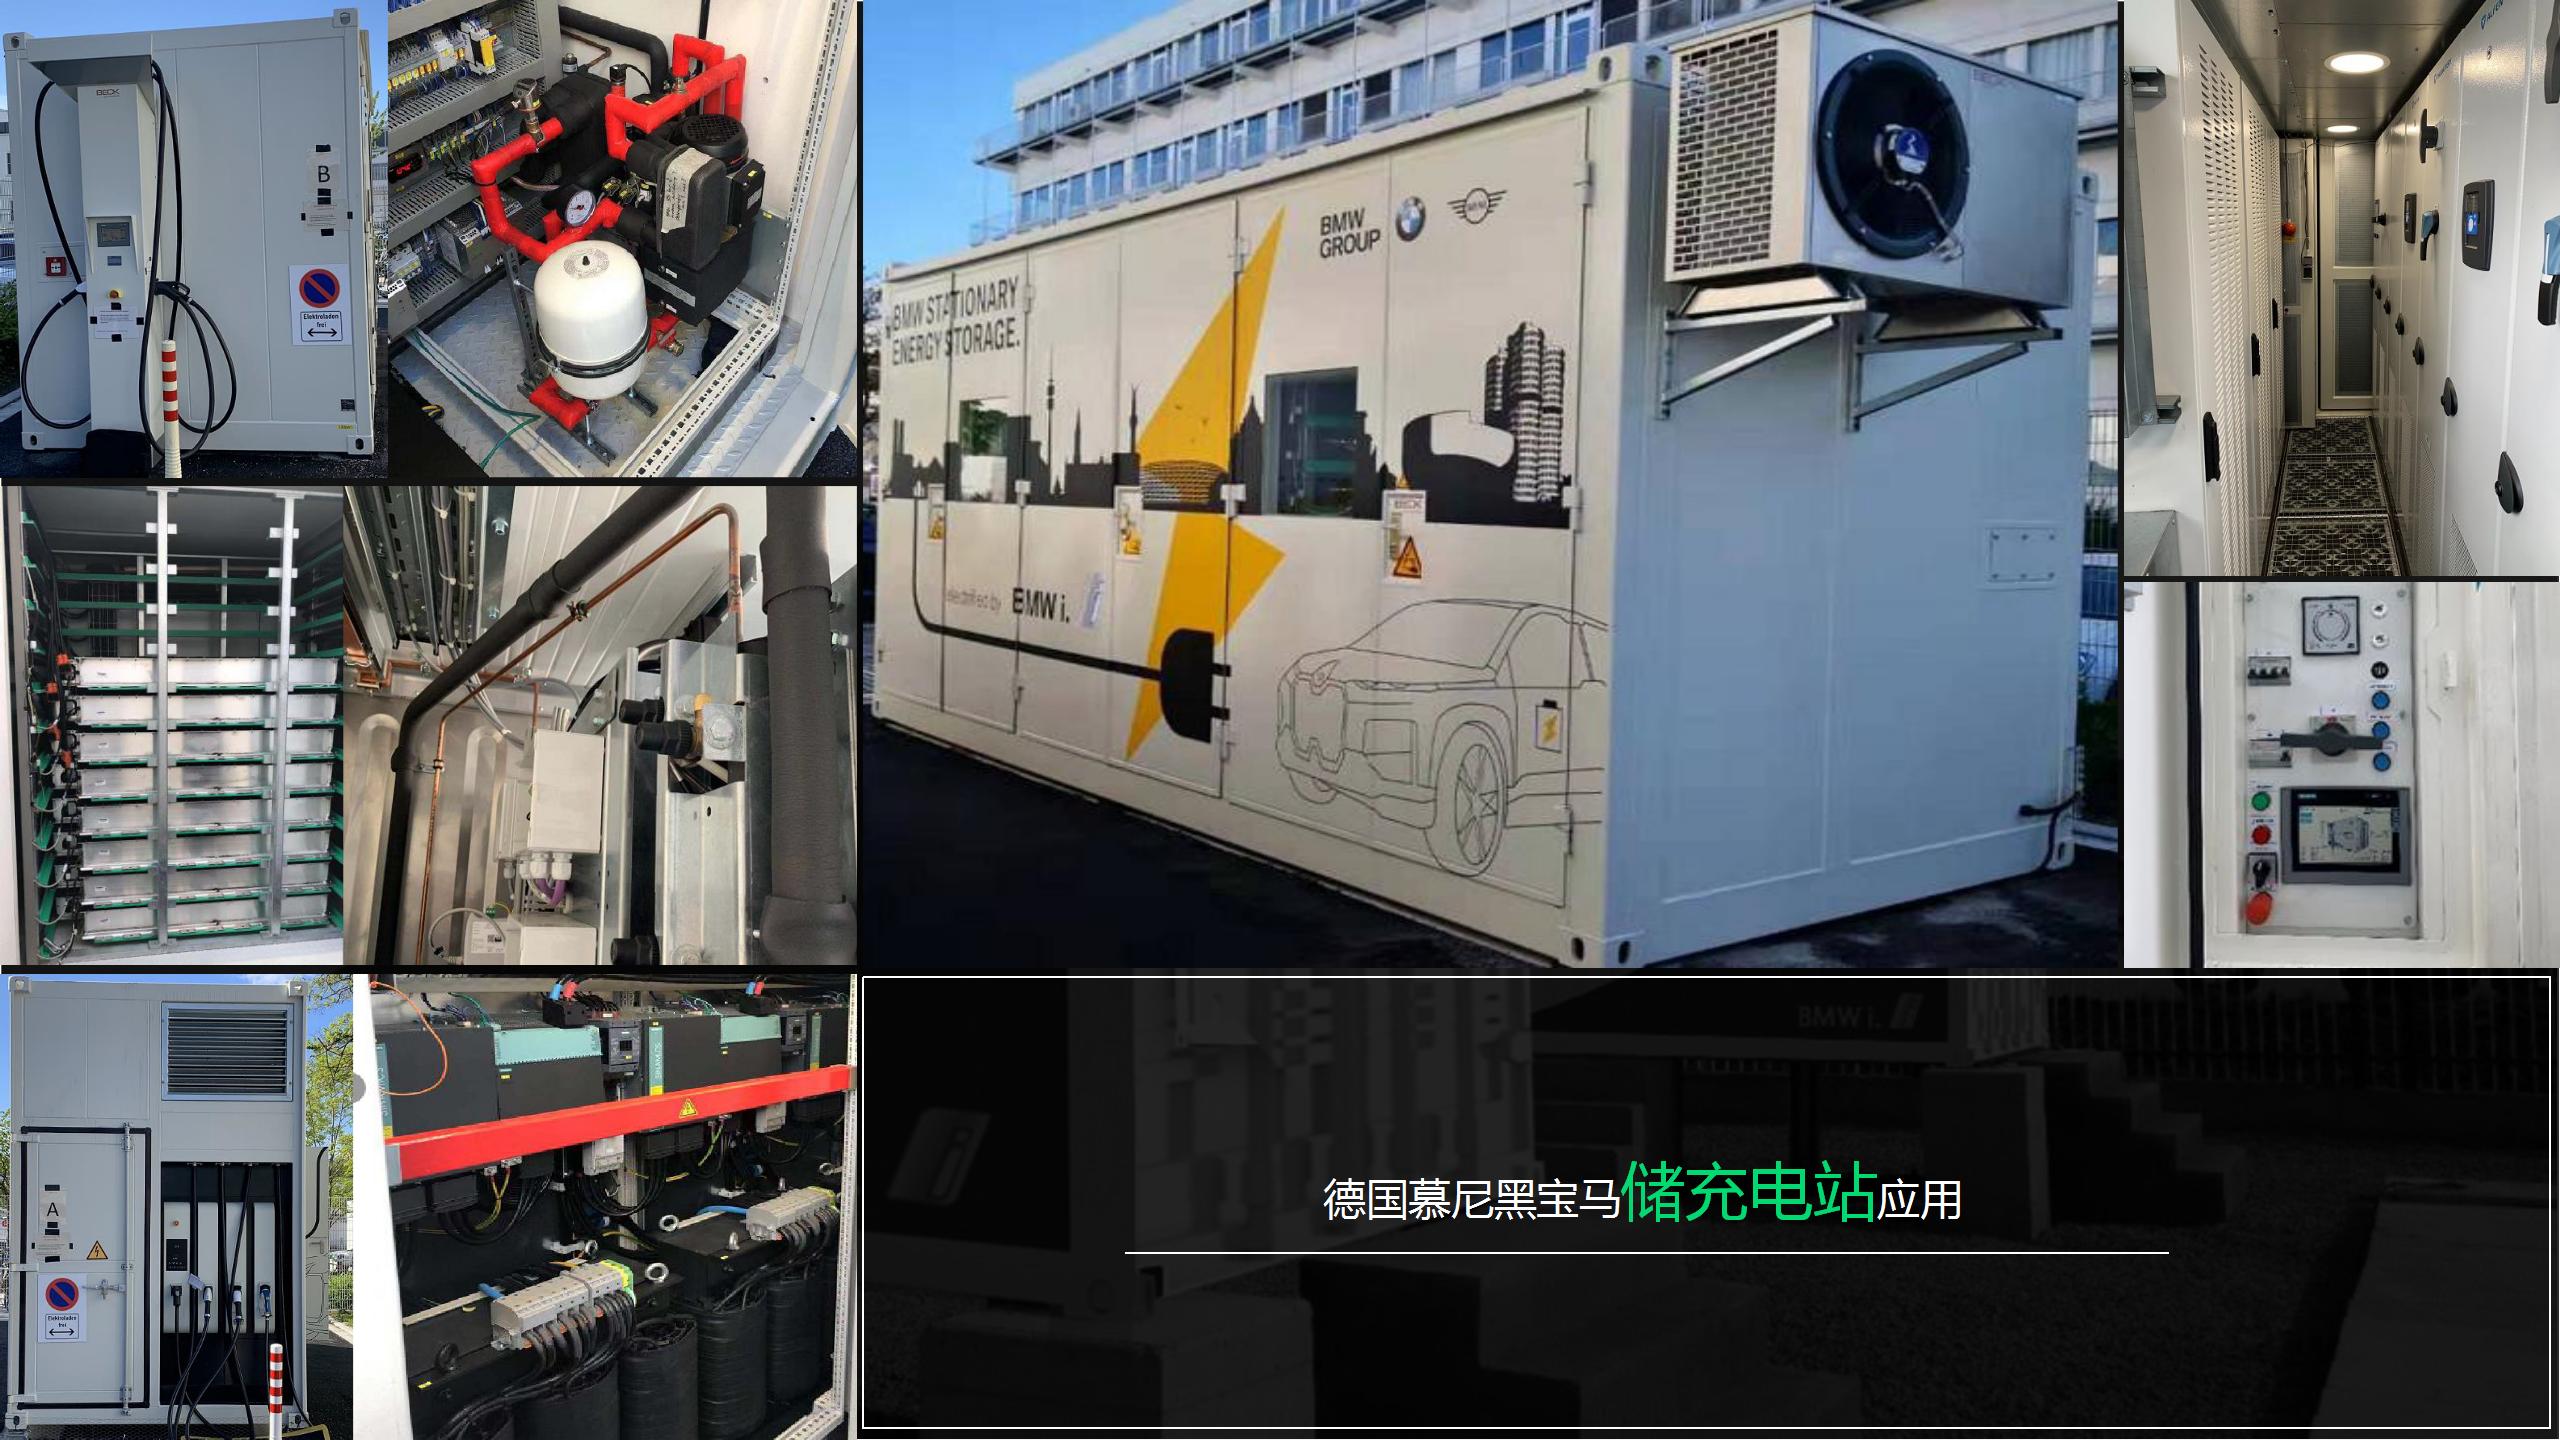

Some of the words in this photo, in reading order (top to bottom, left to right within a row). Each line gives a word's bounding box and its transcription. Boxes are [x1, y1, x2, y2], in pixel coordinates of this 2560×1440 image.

[96, 88, 120, 97] BECK
[318, 165, 331, 183] B
[1320, 207, 1365, 236] BMW
[1319, 228, 1381, 259] GROUP
[893, 300, 925, 331] BMW
[926, 275, 1019, 325] STATIONARY
[892, 330, 942, 366] ENERGY
[945, 316, 1020, 358] STORAGE.
[1012, 587, 1057, 621] BMW
[1798, 1005, 1863, 1029] BMW
[46, 1202, 60, 1217] A
